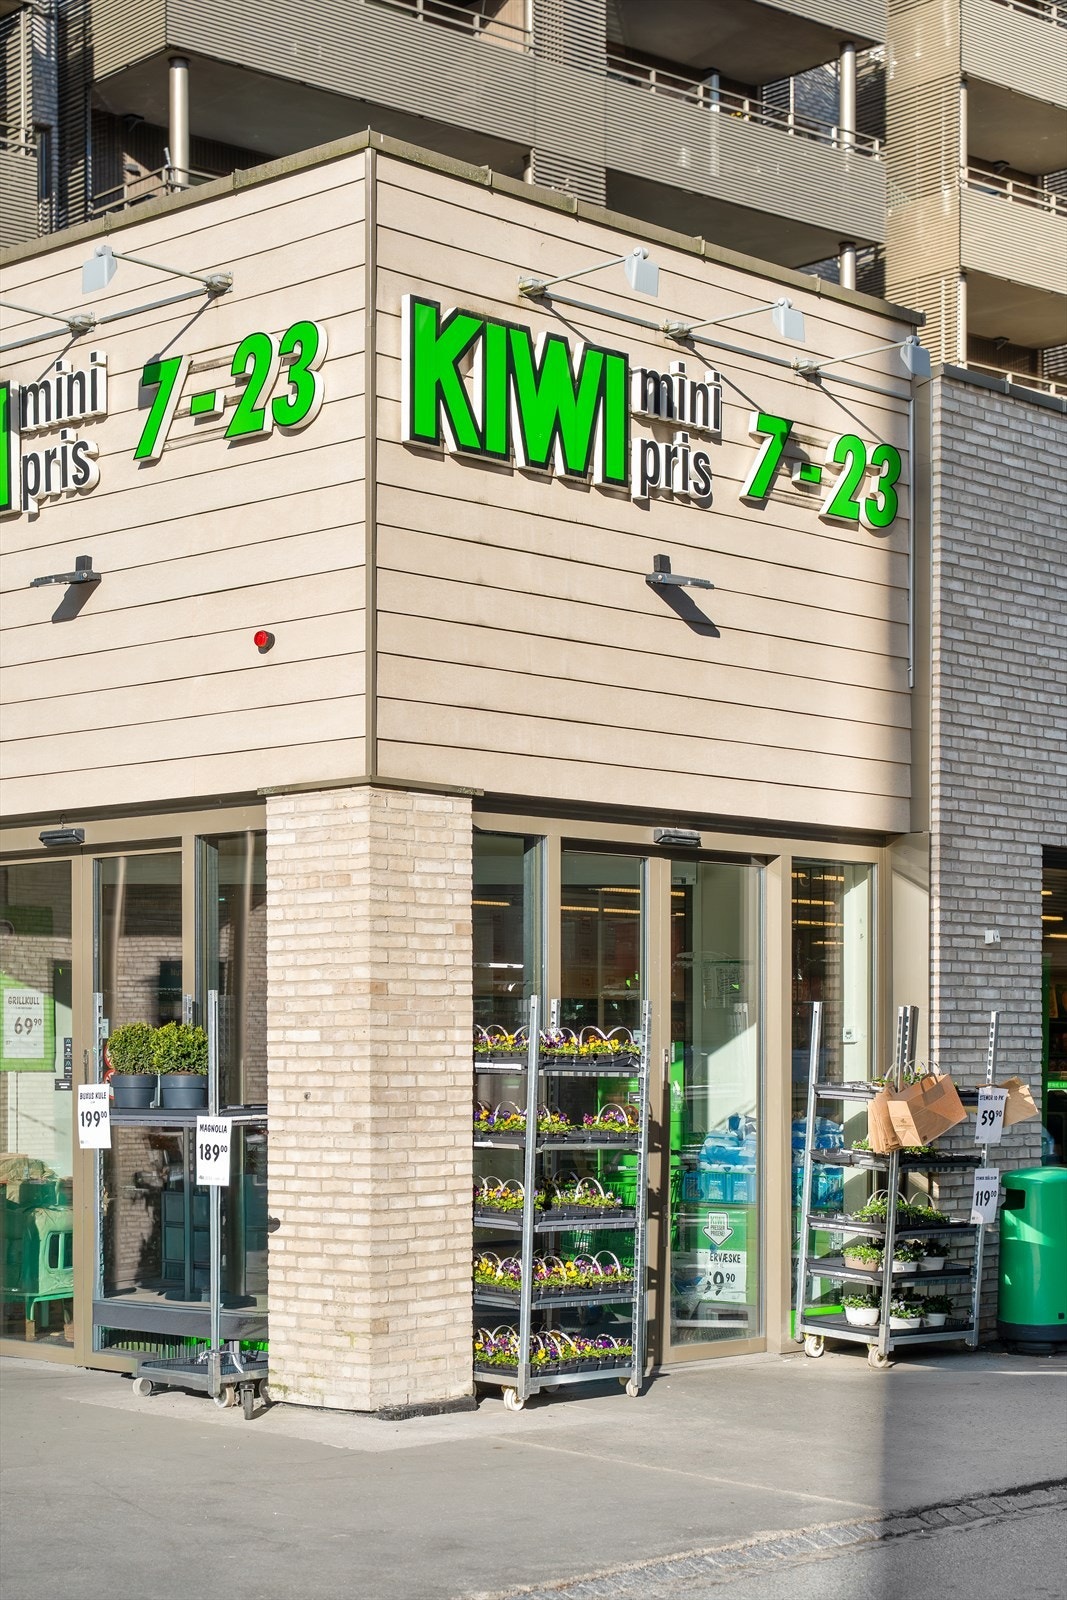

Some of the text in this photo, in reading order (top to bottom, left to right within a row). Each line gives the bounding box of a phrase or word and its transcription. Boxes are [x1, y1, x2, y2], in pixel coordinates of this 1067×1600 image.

[21, 351, 104, 429] mini
[405, 293, 630, 488] KIWI
[635, 360, 721, 432] mini
[22, 429, 97, 512] pris
[635, 432, 712, 499] pris
[8, 996, 40, 1005] GRILLKULL
[199, 1124, 227, 1133] MAGNOLIA
